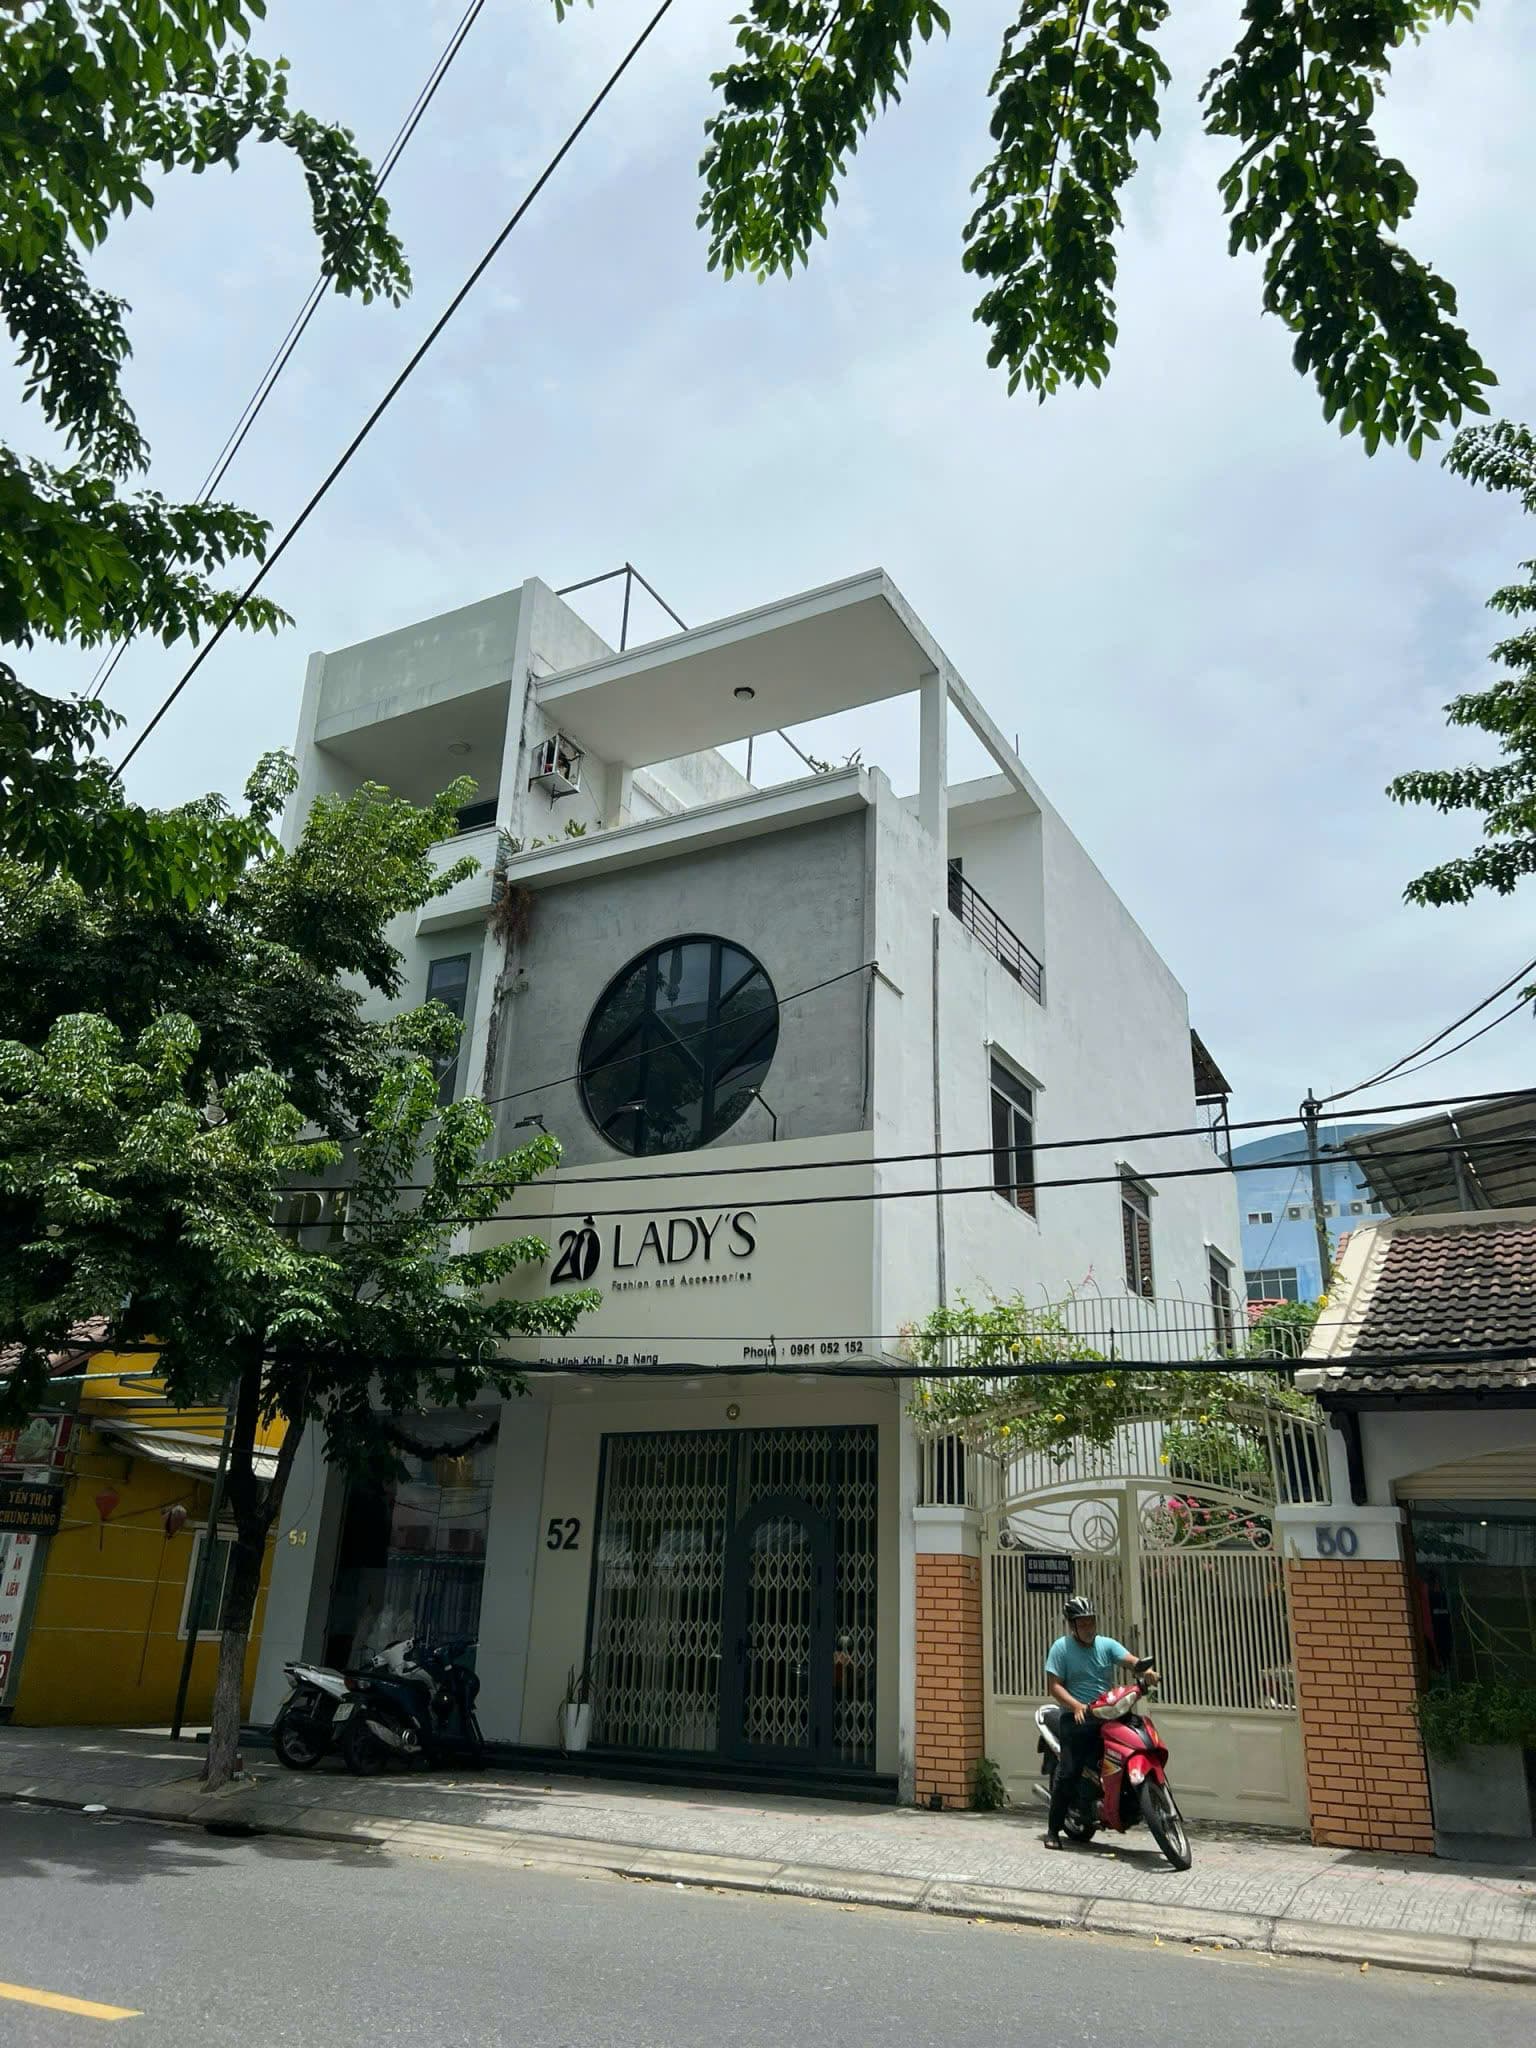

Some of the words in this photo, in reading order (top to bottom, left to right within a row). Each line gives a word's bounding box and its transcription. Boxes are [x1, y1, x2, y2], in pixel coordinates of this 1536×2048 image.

[613, 1211, 757, 1269] LADY'S
[612, 1279, 649, 1292] Fashion
[655, 1276, 675, 1288] and
[680, 1272, 752, 1286] Accessories
[790, 1343, 815, 1356] 0961
[820, 1342, 839, 1355] 052
[845, 1340, 863, 1354] 152
[616, 1354, 629, 1365] Da
[633, 1353, 658, 1366] Nang
[288, 1529, 307, 1546] 54
[547, 1517, 580, 1550] 52
[1316, 1526, 1357, 1556] 50
